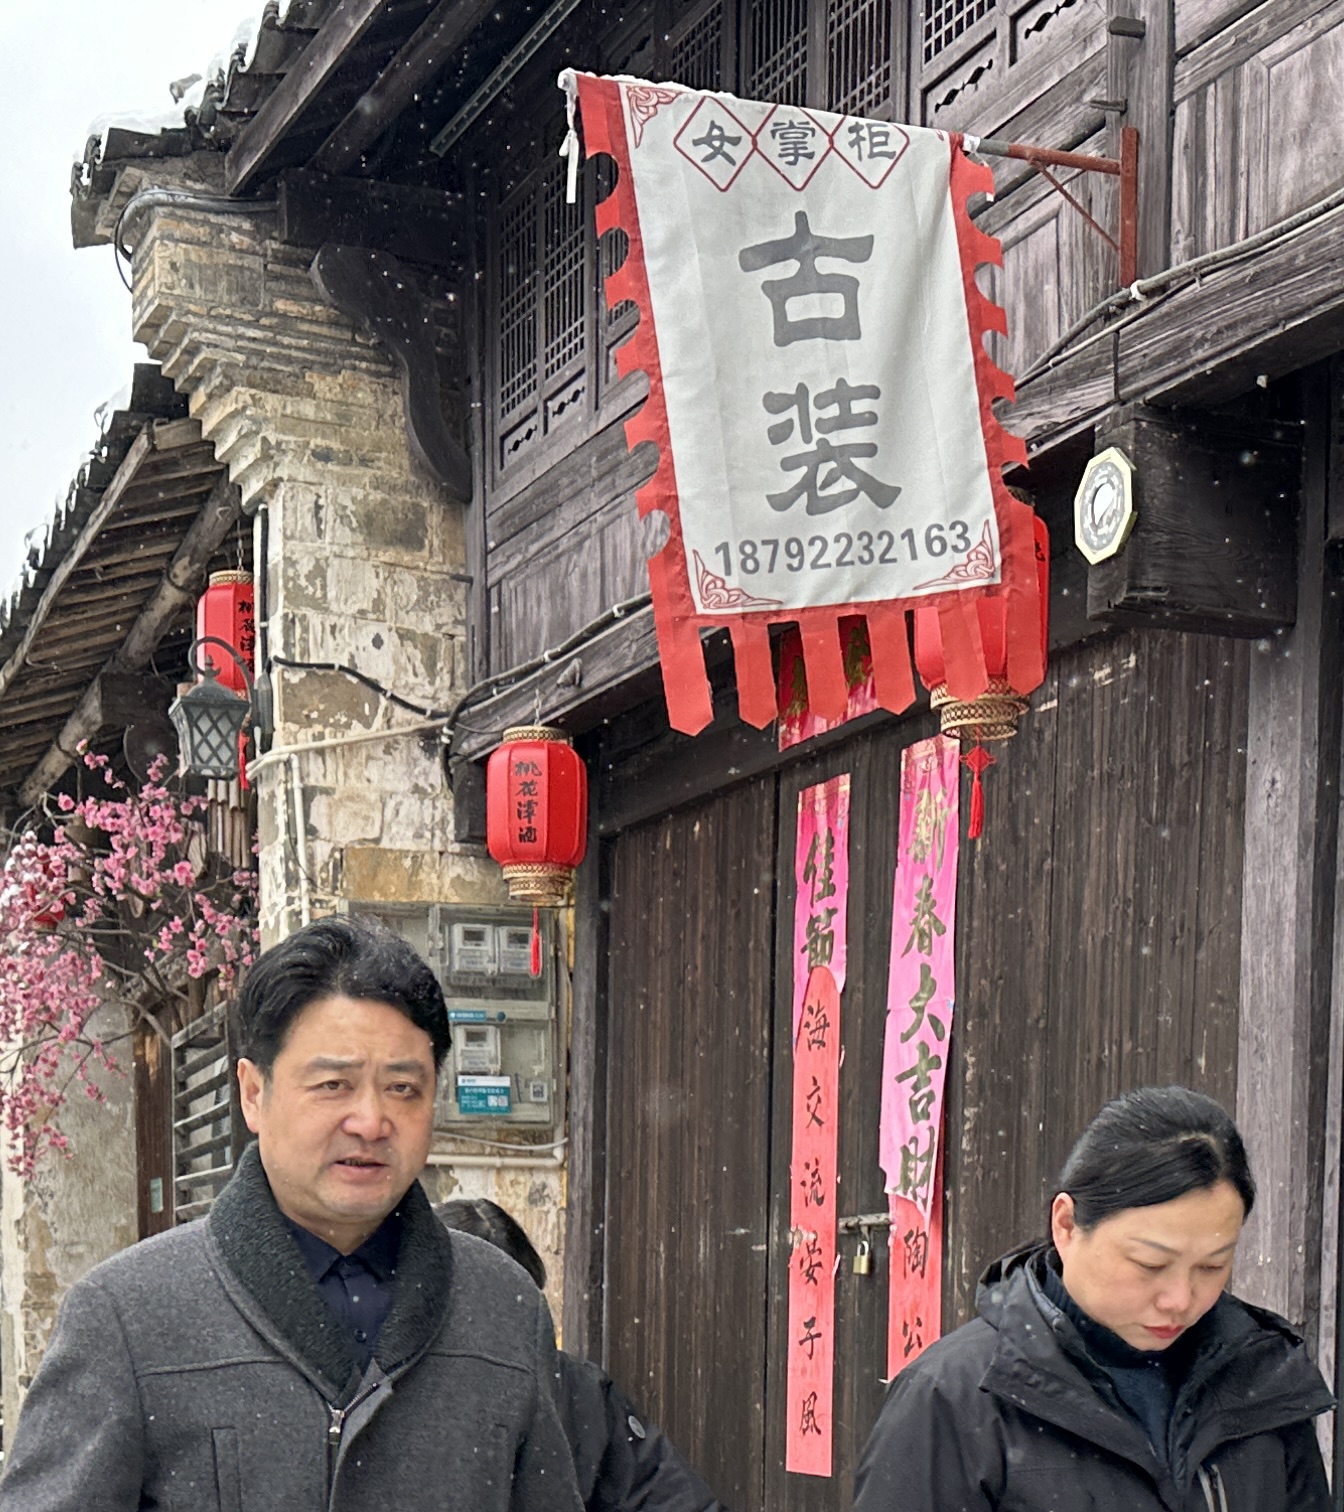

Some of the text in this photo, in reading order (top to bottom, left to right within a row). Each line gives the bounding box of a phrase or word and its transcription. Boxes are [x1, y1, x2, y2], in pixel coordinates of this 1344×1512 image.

[692, 119, 897, 167] 女掌柜
[738, 210, 902, 516] 古装
[714, 519, 972, 578] 18792232163
